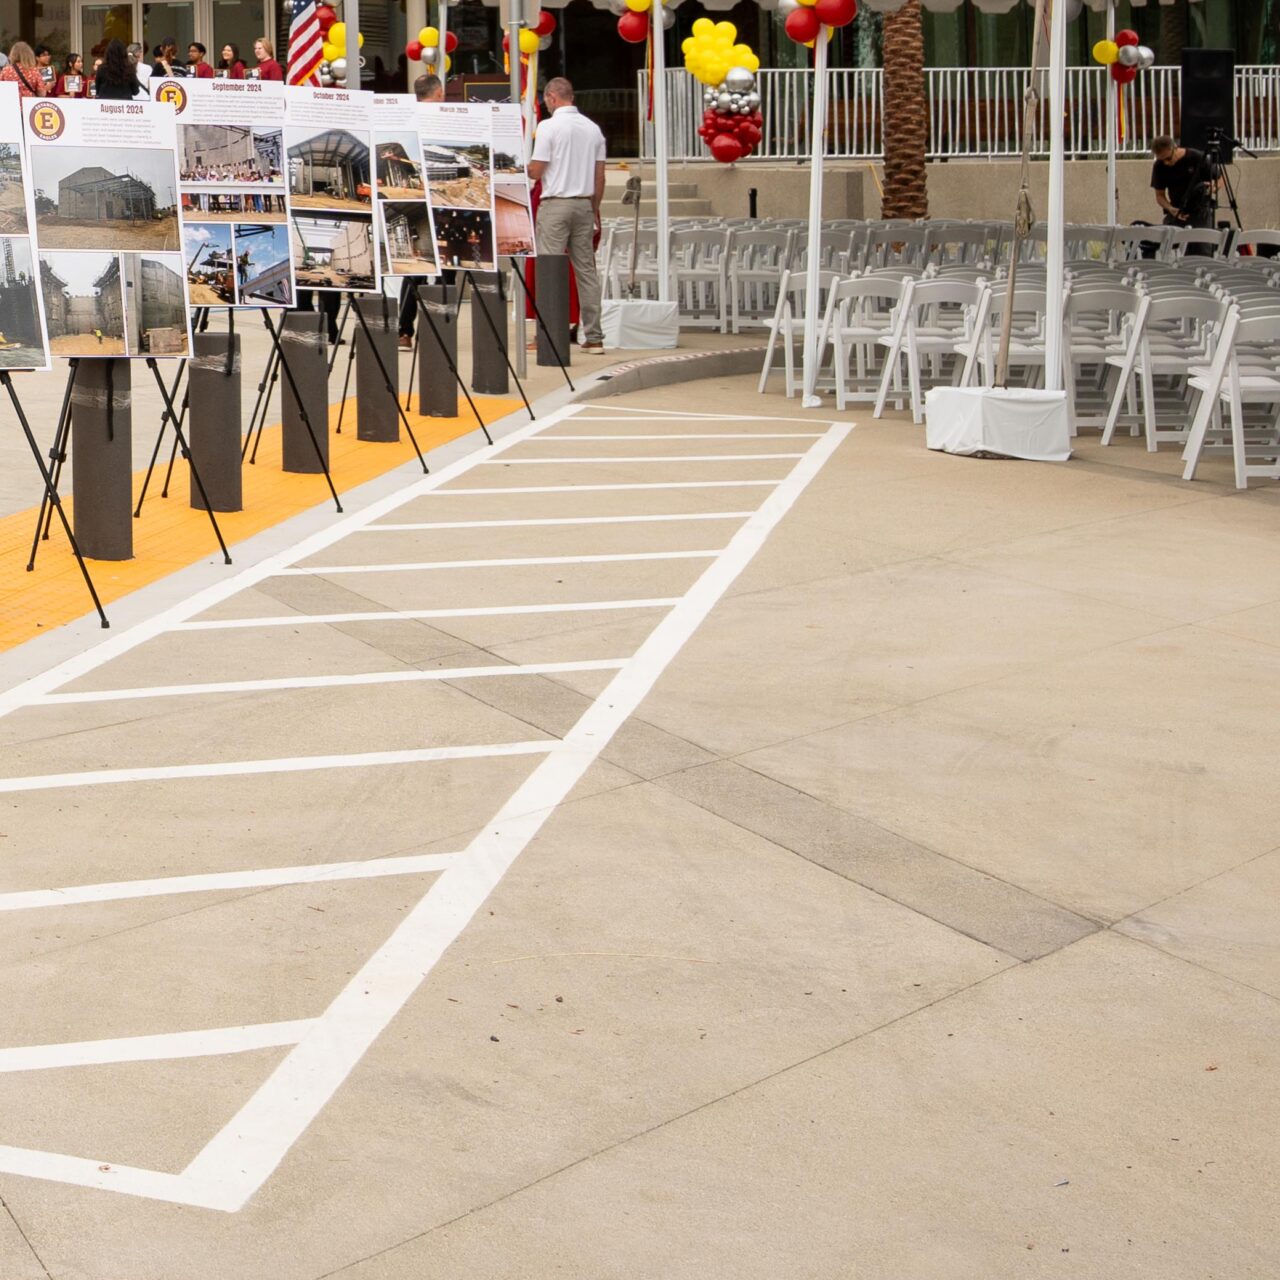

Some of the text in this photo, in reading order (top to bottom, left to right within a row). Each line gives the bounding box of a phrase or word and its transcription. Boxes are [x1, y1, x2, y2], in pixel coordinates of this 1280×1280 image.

[212, 83, 262, 92] September 2024
[313, 92, 334, 100] October
[100, 104, 143, 114] August 2024
[40, 112, 53, 129] E
